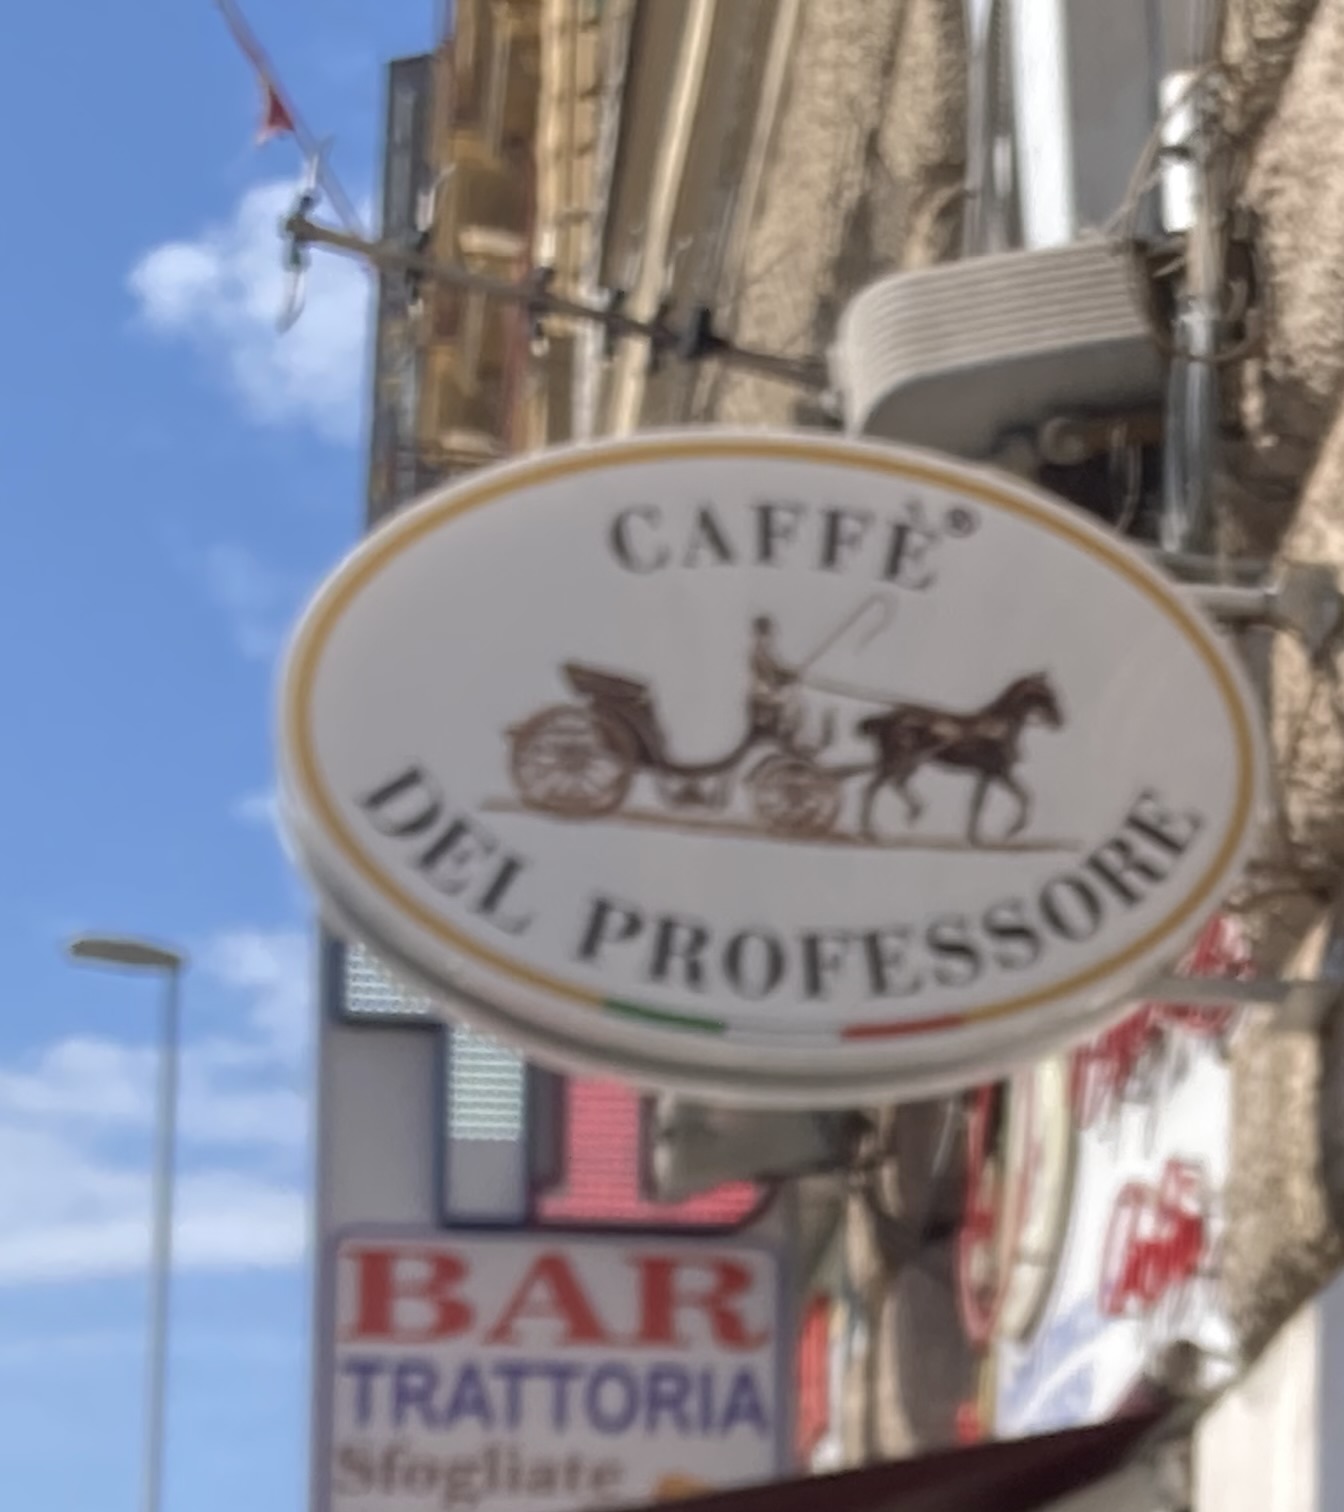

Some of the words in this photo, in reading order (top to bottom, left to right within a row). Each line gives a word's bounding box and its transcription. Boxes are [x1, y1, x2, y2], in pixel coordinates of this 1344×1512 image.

[356, 766, 535, 937] DEL
[572, 784, 1203, 1000] PROFESSORE
[338, 1245, 769, 1354] BAR
[341, 1356, 770, 1437] TRATTORIA
[333, 1441, 625, 1511] Sfogliate
